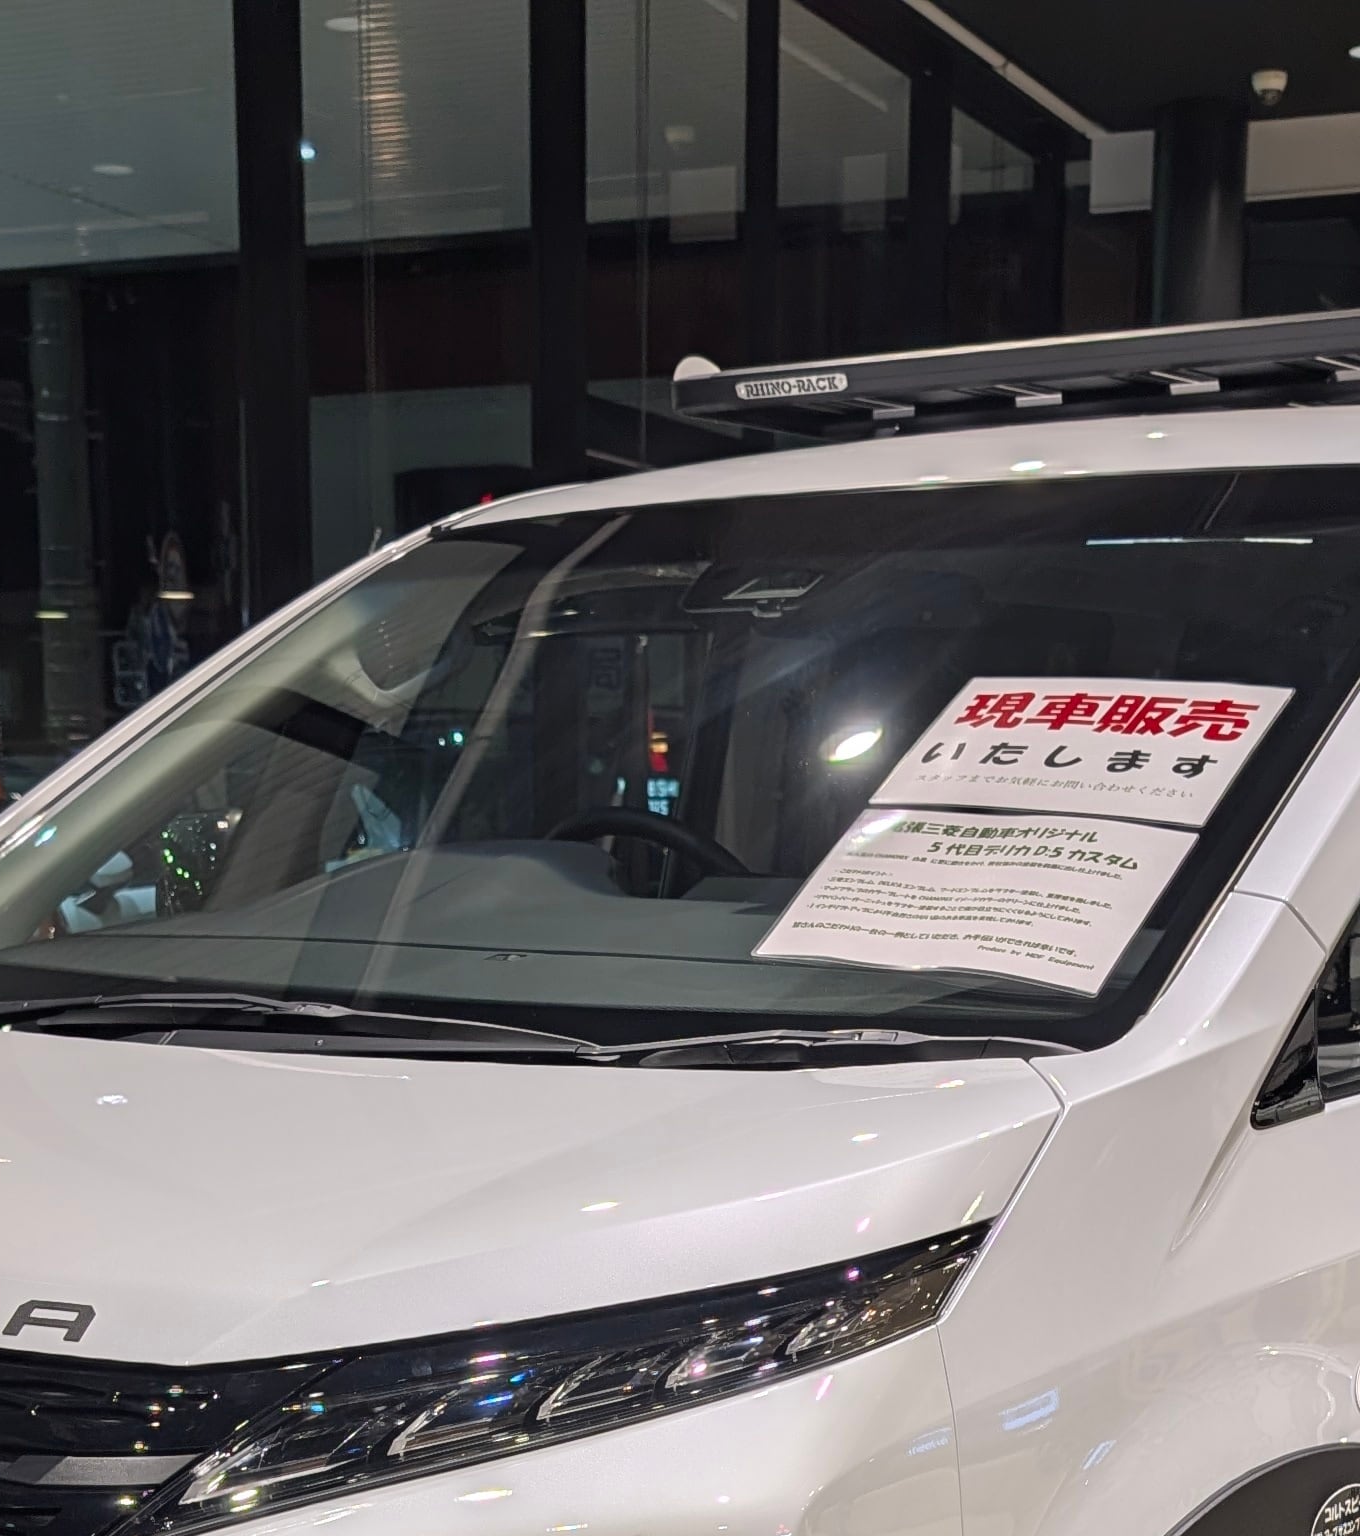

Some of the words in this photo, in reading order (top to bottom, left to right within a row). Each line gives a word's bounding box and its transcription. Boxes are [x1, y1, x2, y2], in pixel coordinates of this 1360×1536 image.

[744, 375, 839, 398] RHINO-RACK
[953, 692, 1259, 741] 現車販売
[921, 742, 1220, 779] いたします
